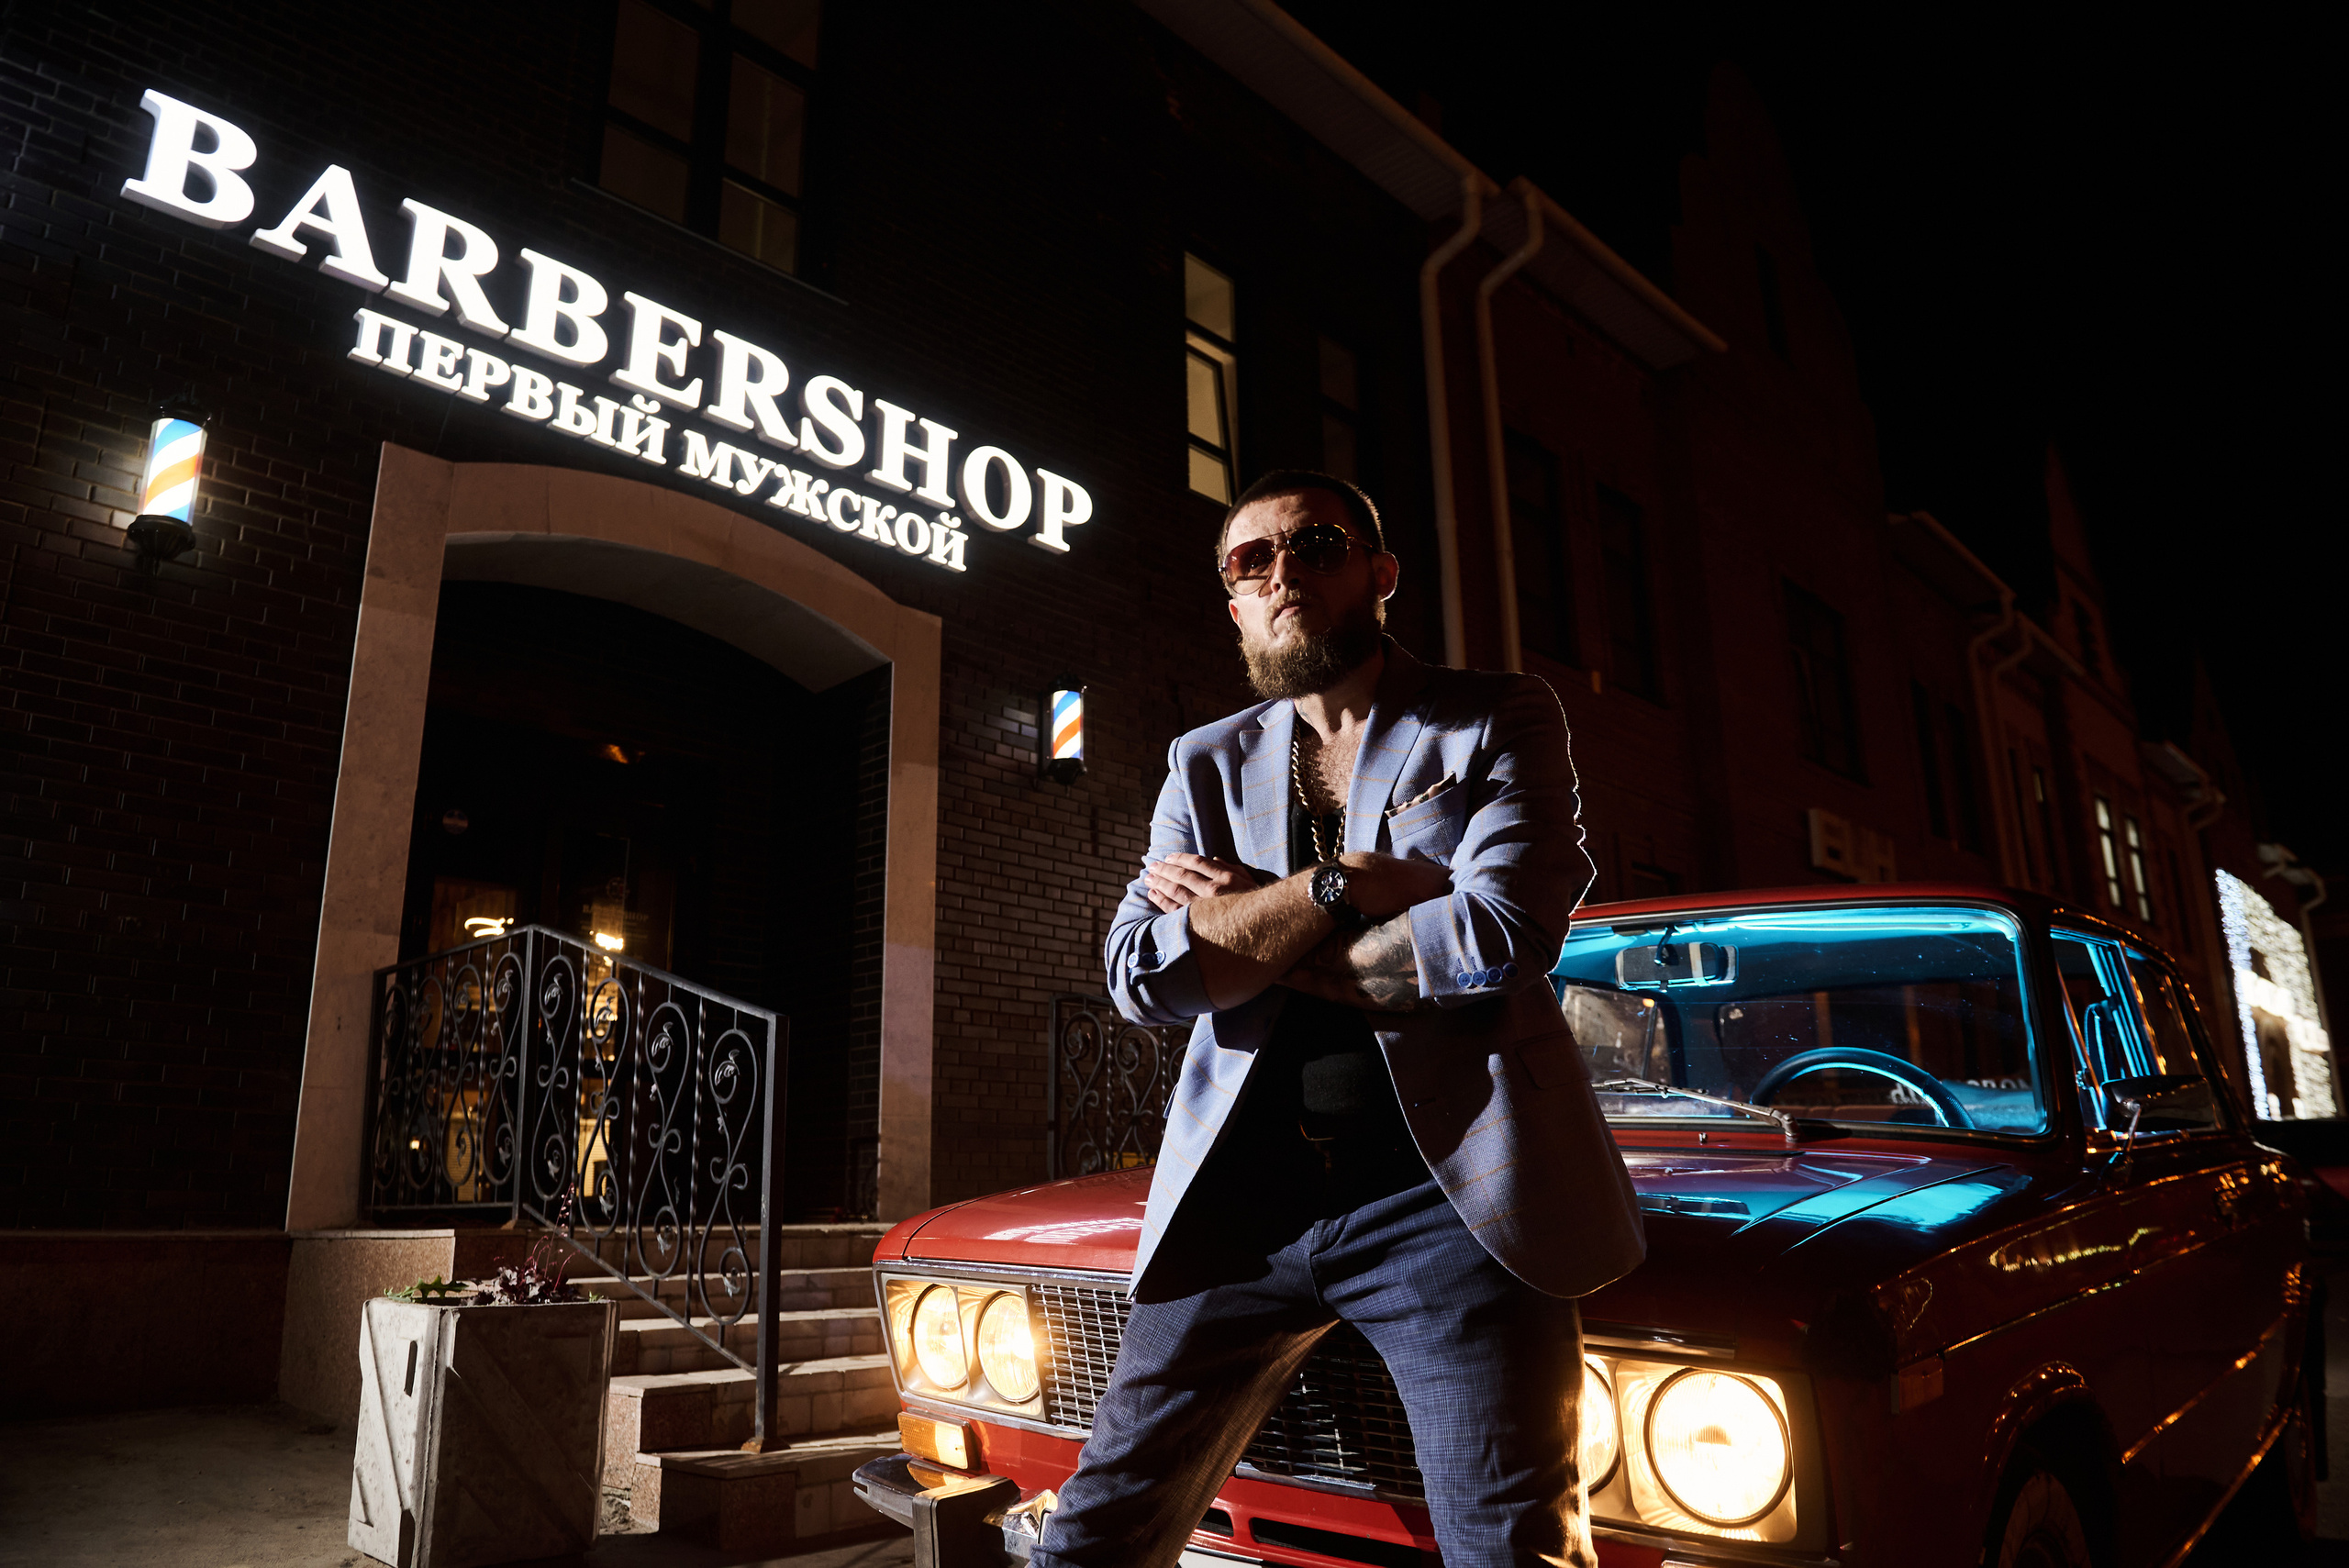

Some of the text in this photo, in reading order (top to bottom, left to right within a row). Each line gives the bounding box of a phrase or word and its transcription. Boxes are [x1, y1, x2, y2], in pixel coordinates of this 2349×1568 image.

[121, 88, 1095, 555] BARBERSHOP
[349, 307, 970, 573] ПЕРВЫЙ МУЖСКОЙ
